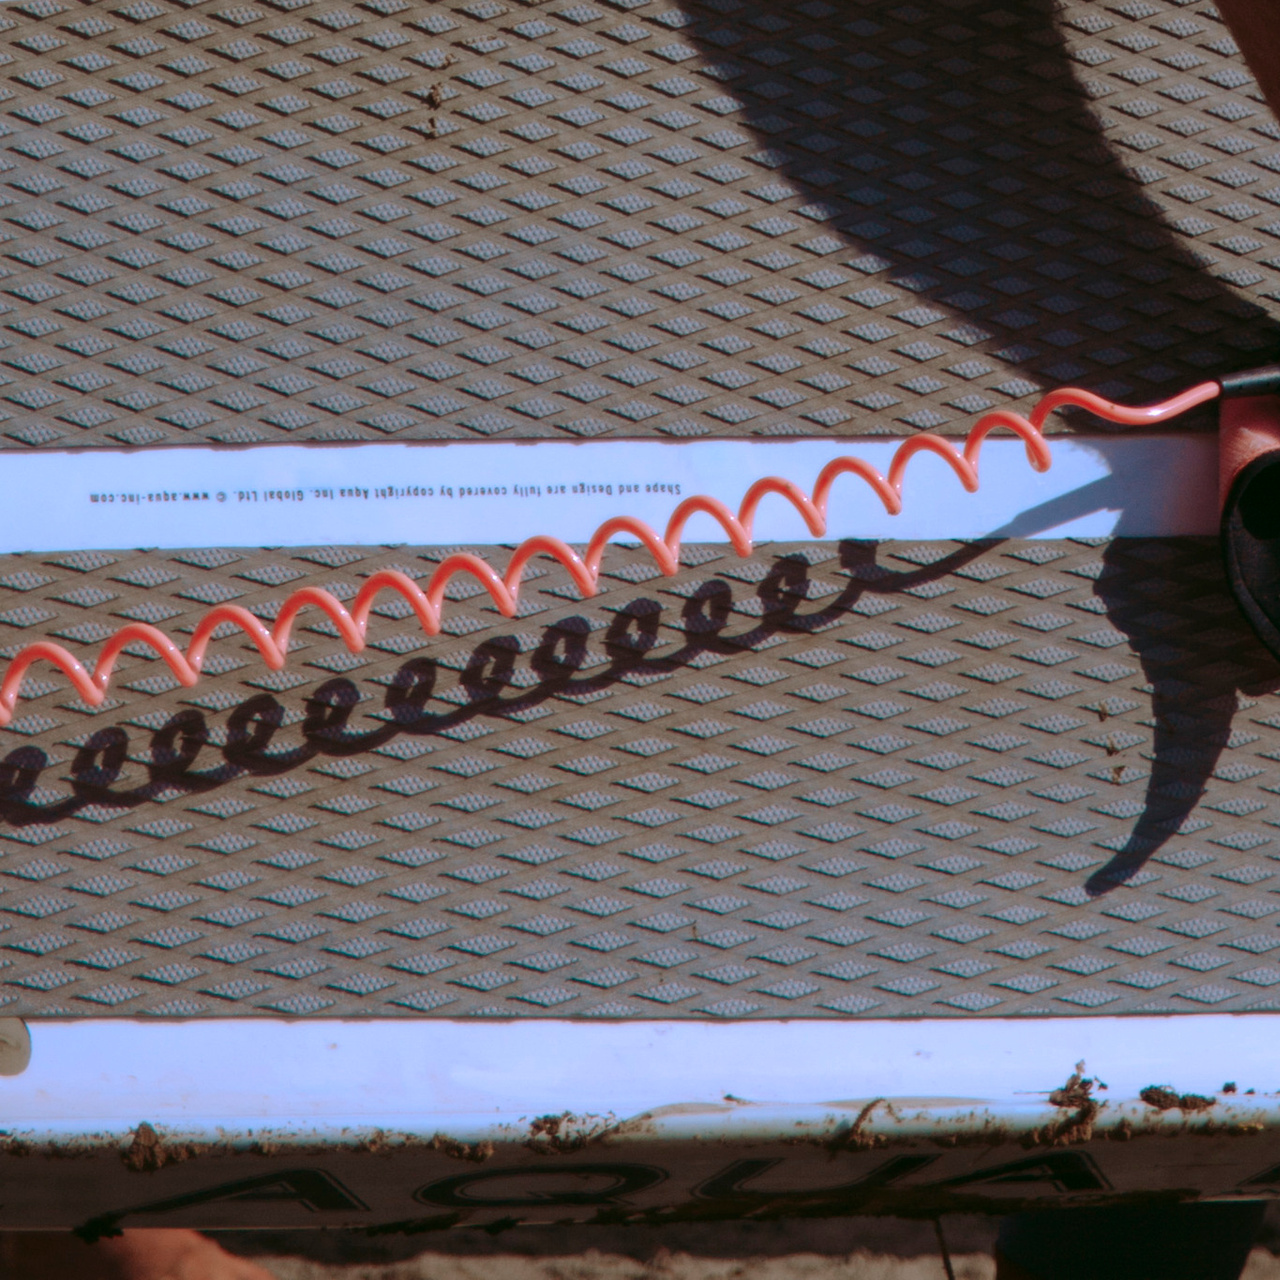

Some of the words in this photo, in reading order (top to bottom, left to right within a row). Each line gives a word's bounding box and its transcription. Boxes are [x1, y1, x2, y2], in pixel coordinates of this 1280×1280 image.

[308, 488, 334, 501] Inc.
[338, 486, 370, 501] Aqua
[374, 486, 434, 500] copyright
[438, 485, 455, 500] by
[458, 486, 507, 498] covered
[511, 483, 542, 498] fully
[545, 485, 568, 495] are
[571, 482, 614, 497] Design
[617, 482, 641, 495] and
[645, 483, 681, 496] Shape
[90, 491, 210, 504] www.aqua-inc.com
[233, 490, 259, 503] Ltd.
[263, 489, 305, 502] Global
[98, 1150, 1114, 1216] AQUA
